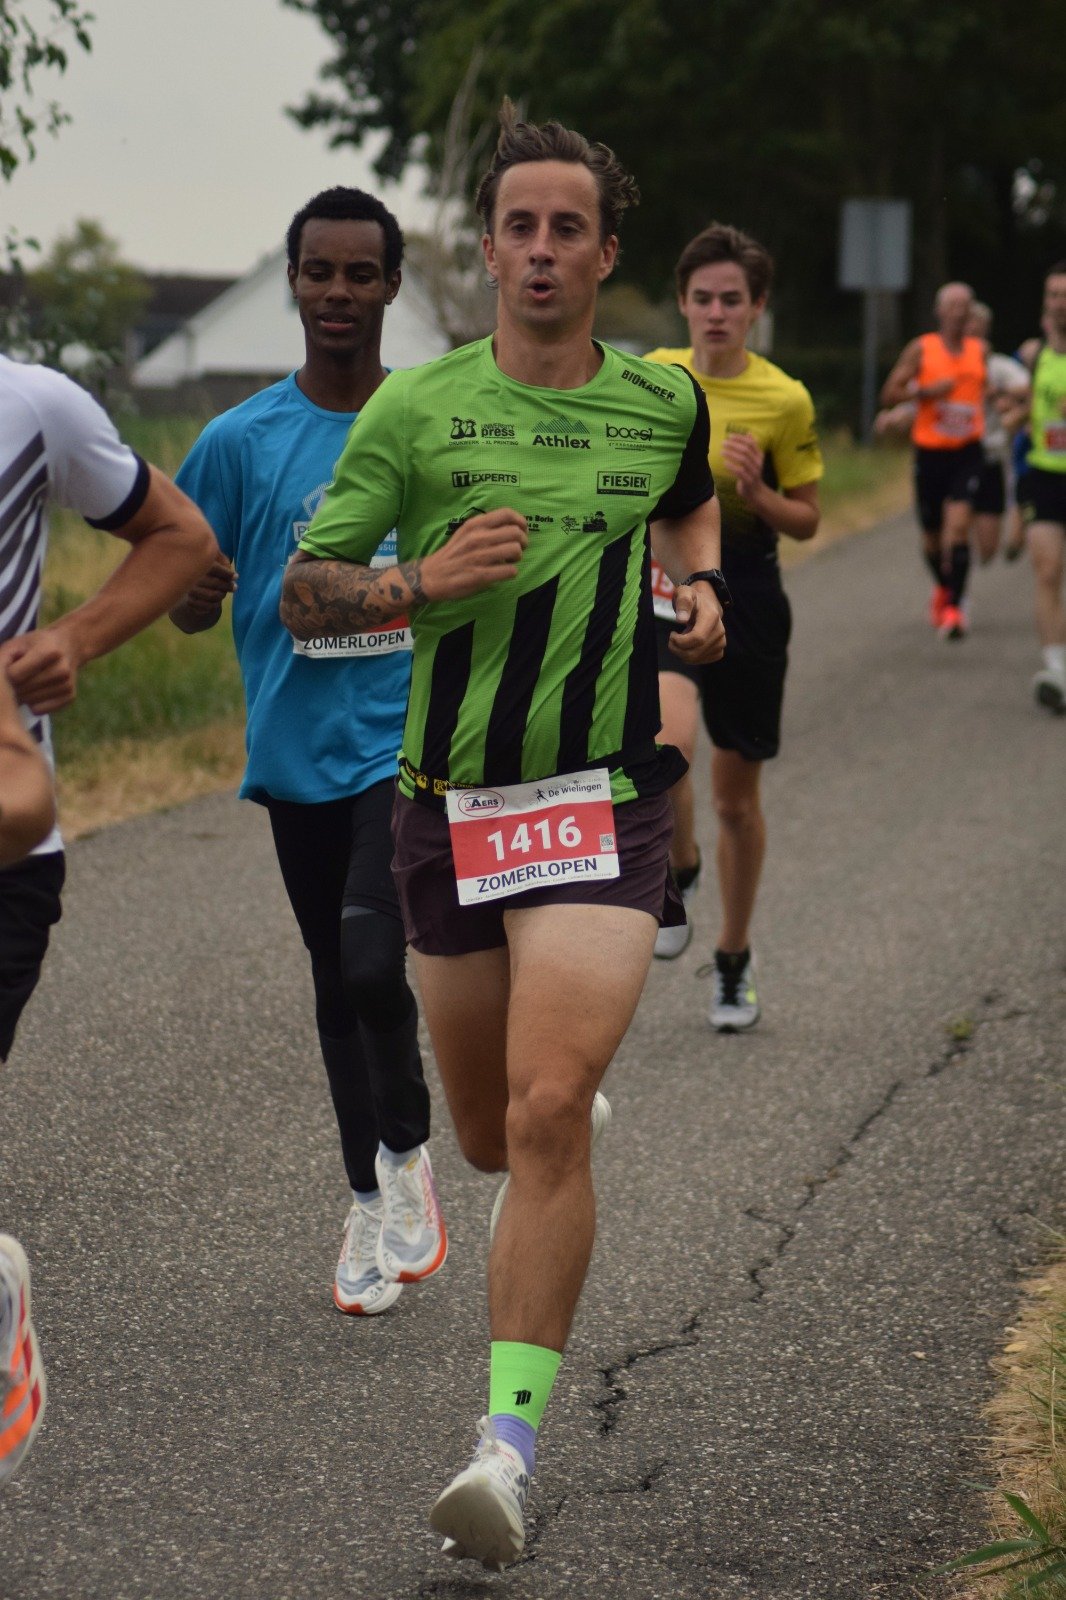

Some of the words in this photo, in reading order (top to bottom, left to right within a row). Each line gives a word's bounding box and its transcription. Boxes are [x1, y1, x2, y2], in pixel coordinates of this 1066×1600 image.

[481, 427, 515, 438] press
[532, 434, 591, 450] Athlex
[453, 472, 468, 486] IT
[471, 473, 518, 484] EXPERTS
[602, 475, 647, 489] FIESIEK
[303, 630, 405, 650] ZOMERLOPEN
[548, 789, 560, 798] De
[560, 783, 602, 794] Wielingen
[487, 815, 582, 861] 1416
[476, 857, 598, 893] ZOMERLOPEN
